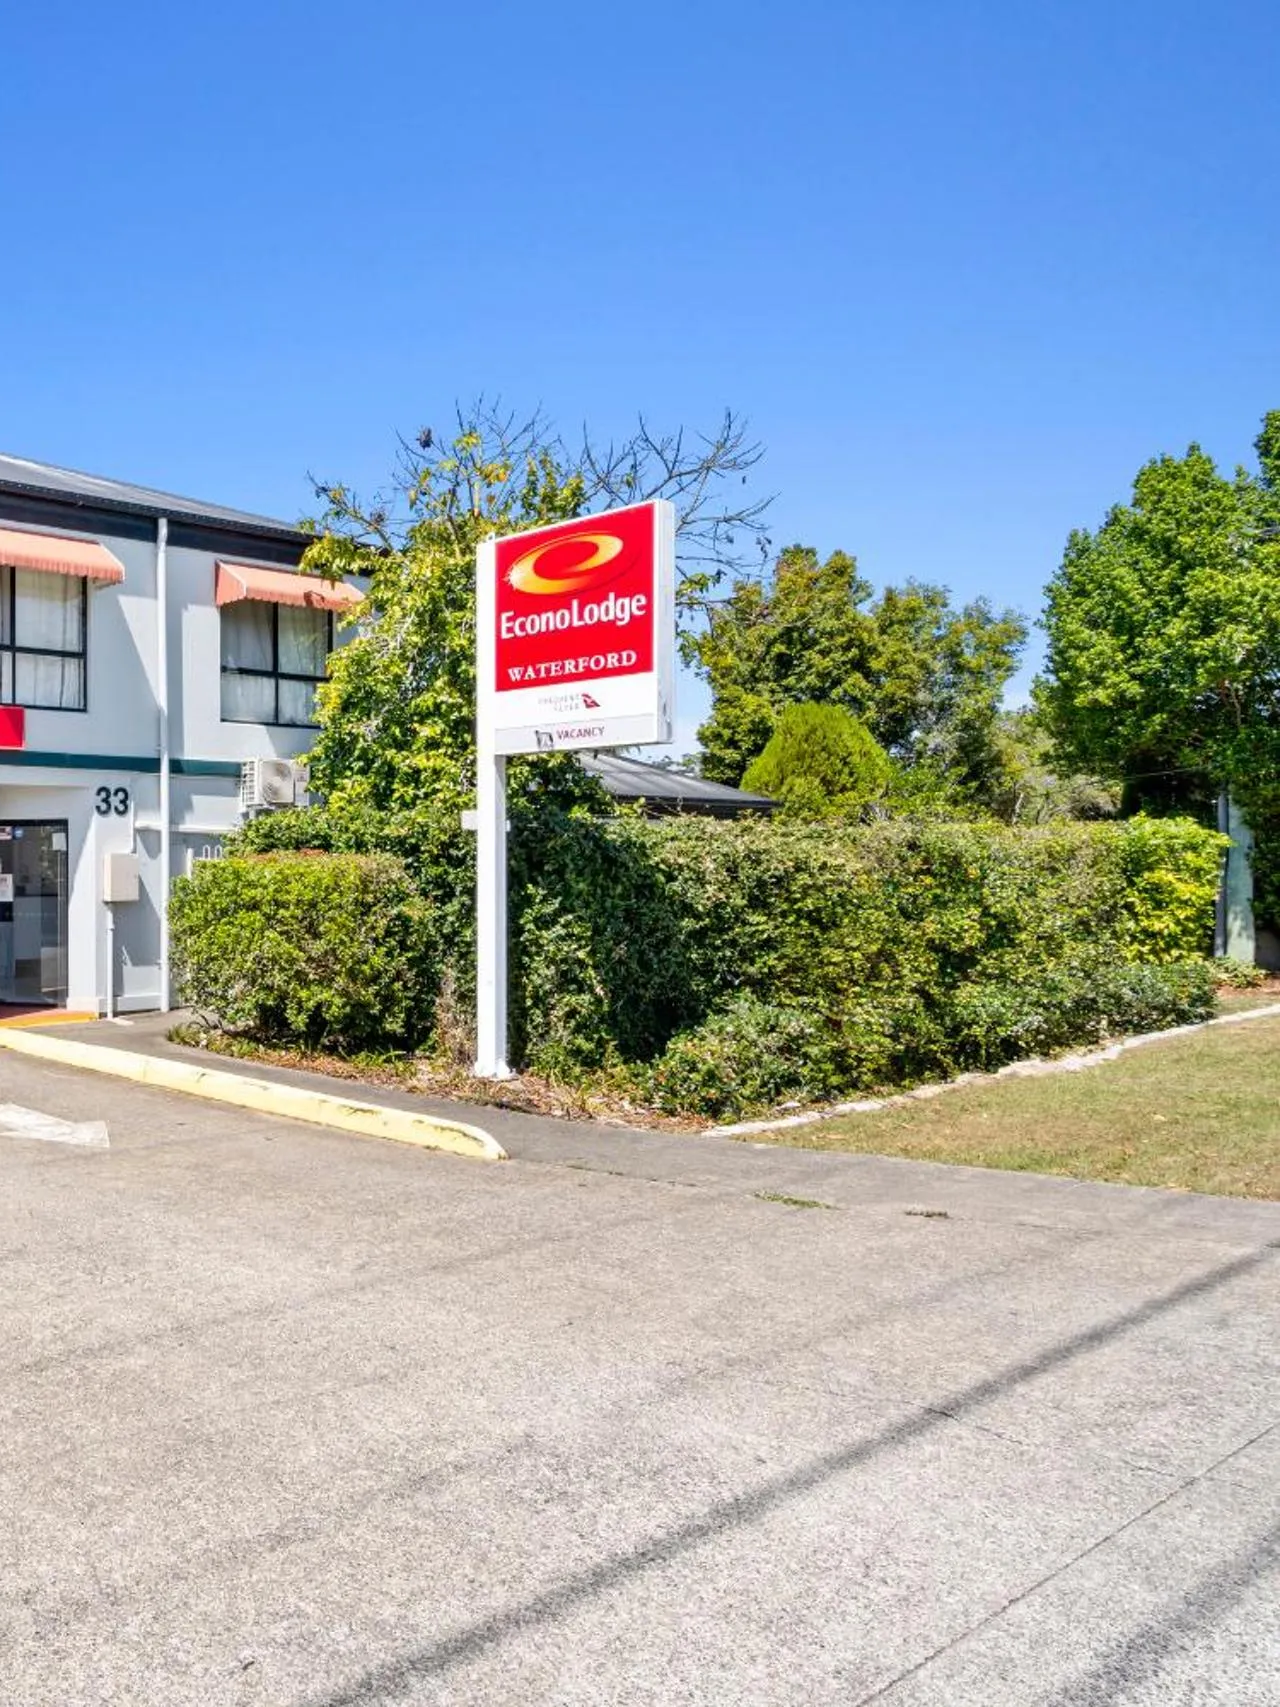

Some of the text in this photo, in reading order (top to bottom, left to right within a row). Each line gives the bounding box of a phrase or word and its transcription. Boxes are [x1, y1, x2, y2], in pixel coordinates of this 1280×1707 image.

[500, 591, 646, 640] EconoLodge
[507, 650, 637, 682] WATERFORD
[556, 726, 605, 740] VACANCY
[95, 786, 129, 817] 33
